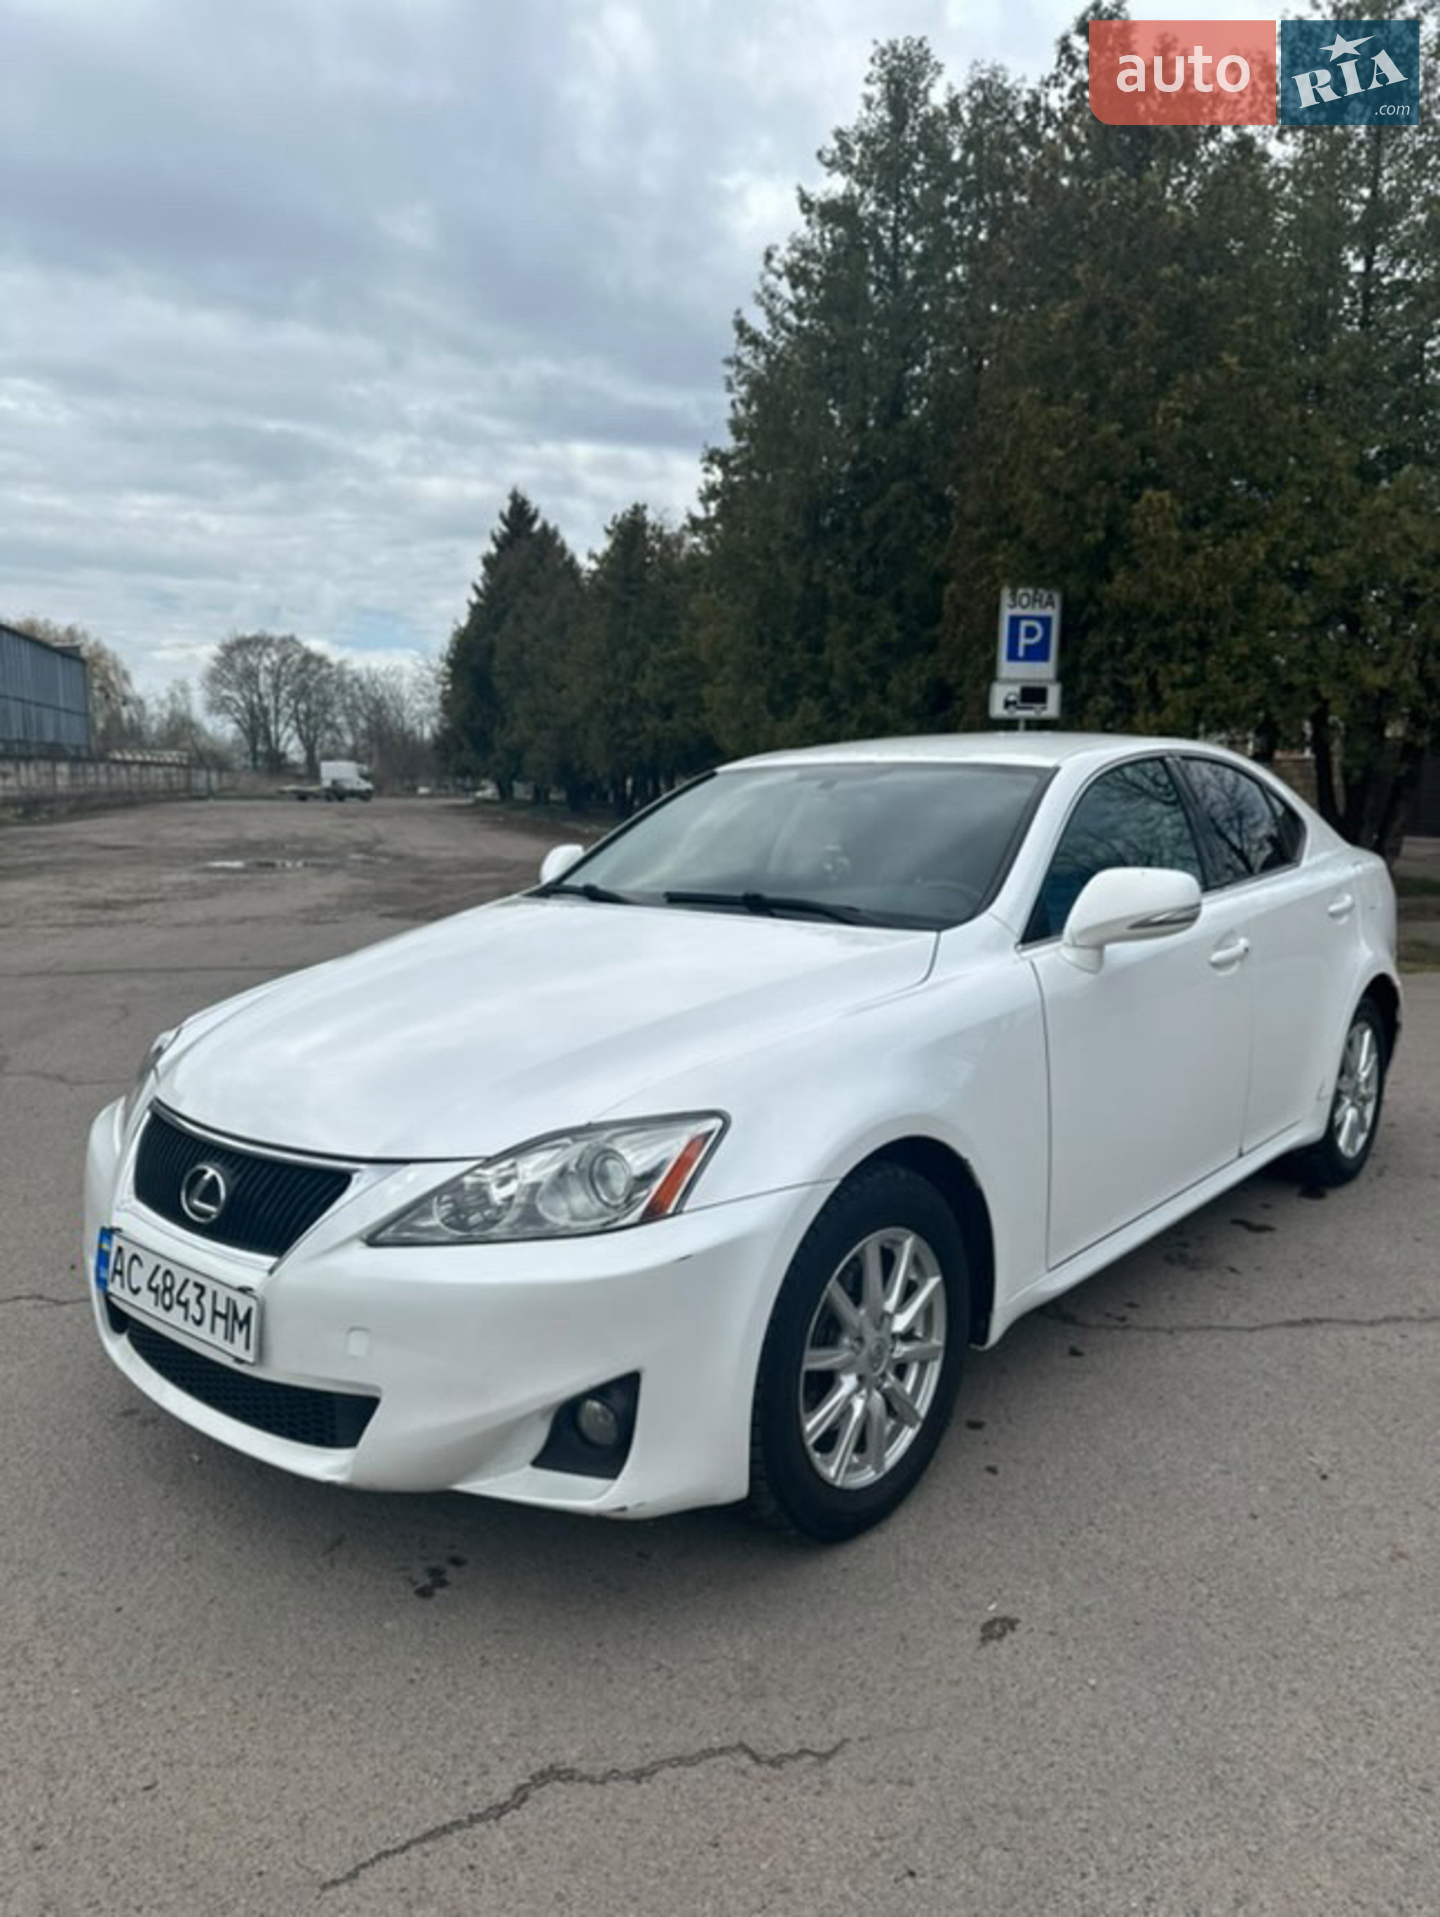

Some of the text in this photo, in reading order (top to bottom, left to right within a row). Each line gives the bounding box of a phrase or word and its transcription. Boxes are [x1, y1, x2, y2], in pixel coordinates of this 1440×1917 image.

[1008, 591, 1055, 609] ЗОНА
[111, 1245, 253, 1352] AC 4843 HM
